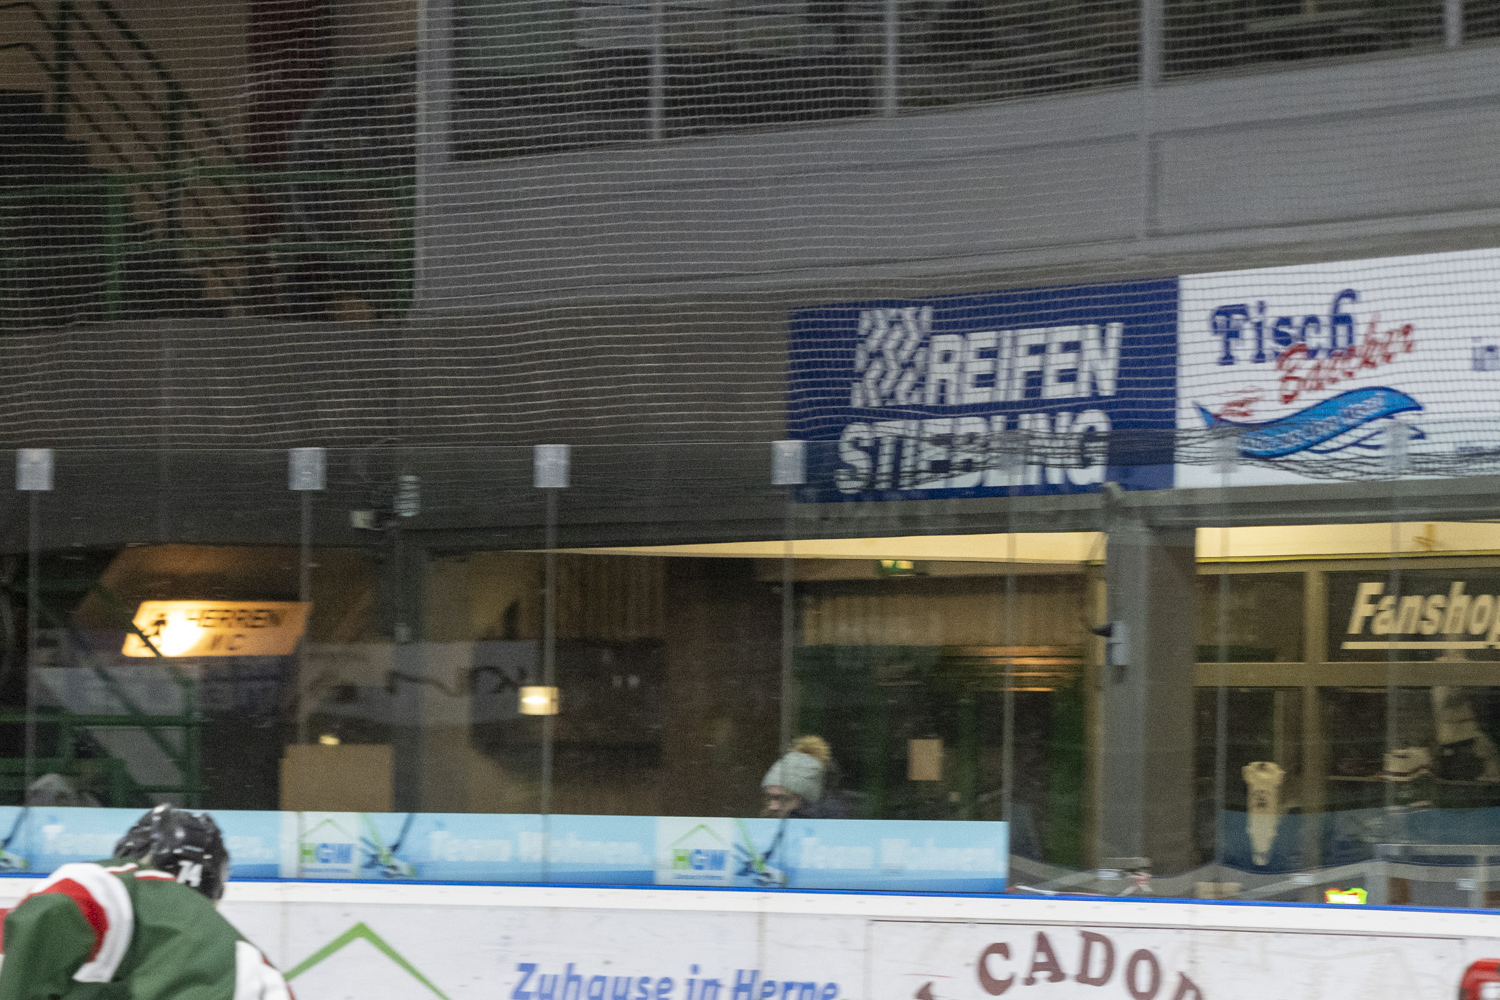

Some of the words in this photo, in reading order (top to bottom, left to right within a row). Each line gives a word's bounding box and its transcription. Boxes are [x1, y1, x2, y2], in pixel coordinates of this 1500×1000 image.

[923, 322, 1125, 406] REIFEN
[1210, 288, 1360, 367] Fisch
[834, 409, 1112, 494] STIEBLING
